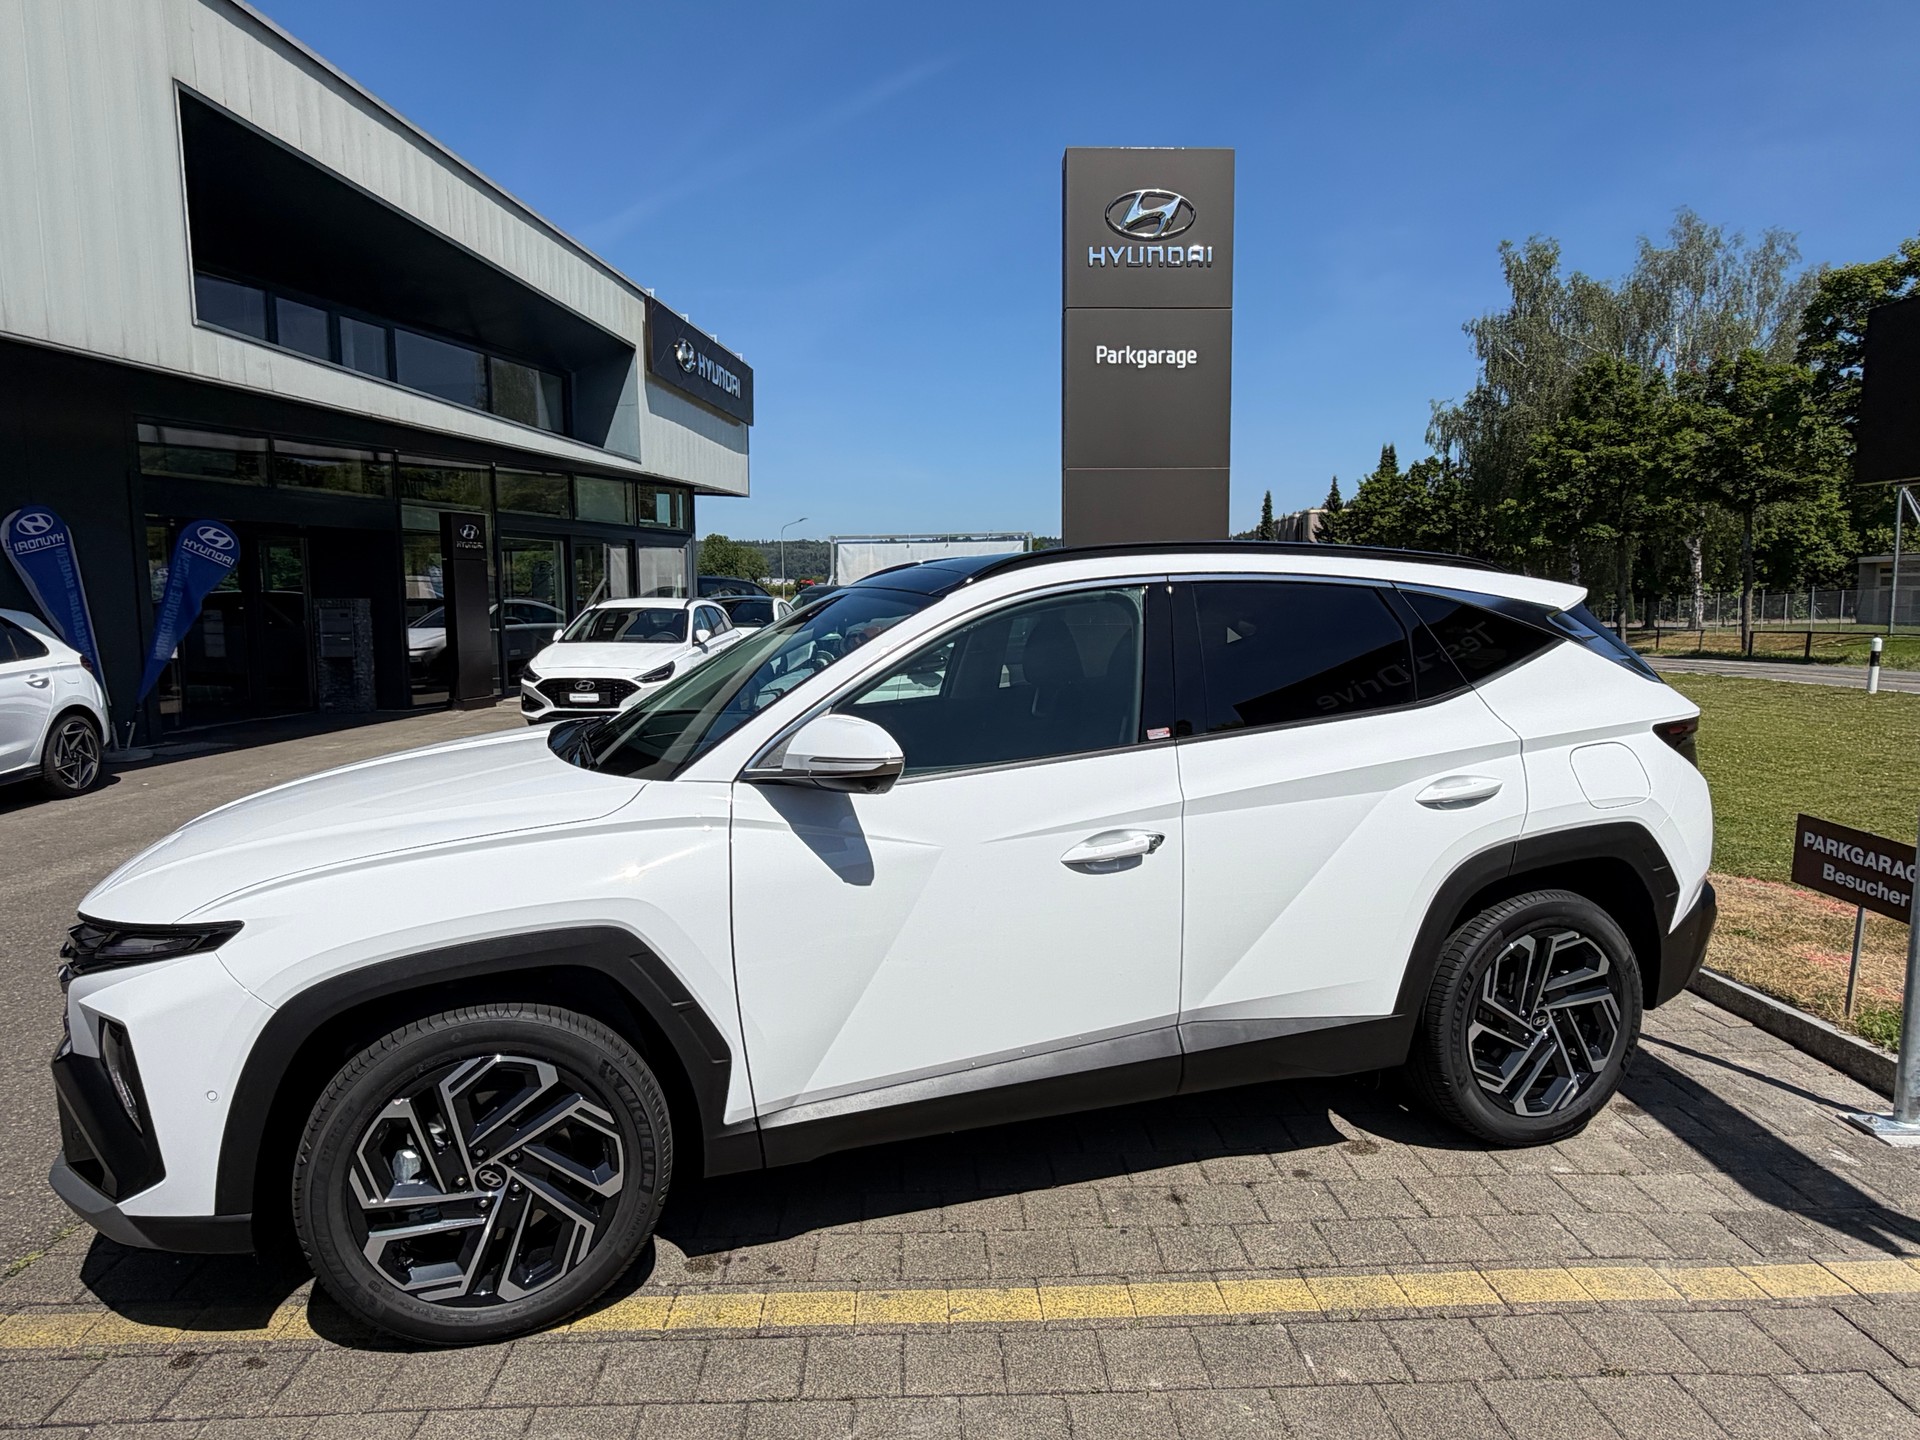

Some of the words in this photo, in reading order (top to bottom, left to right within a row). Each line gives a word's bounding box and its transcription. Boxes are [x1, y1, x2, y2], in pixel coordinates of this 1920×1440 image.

[1088, 245, 1213, 267] HYUNDAI
[1096, 345, 1198, 368] Parkgarage
[697, 352, 741, 399] HYUNDAI
[183, 538, 235, 566] HYUNDAI
[1822, 862, 1910, 907] Besucher
[619, 1085, 655, 1188] MICHELIN
